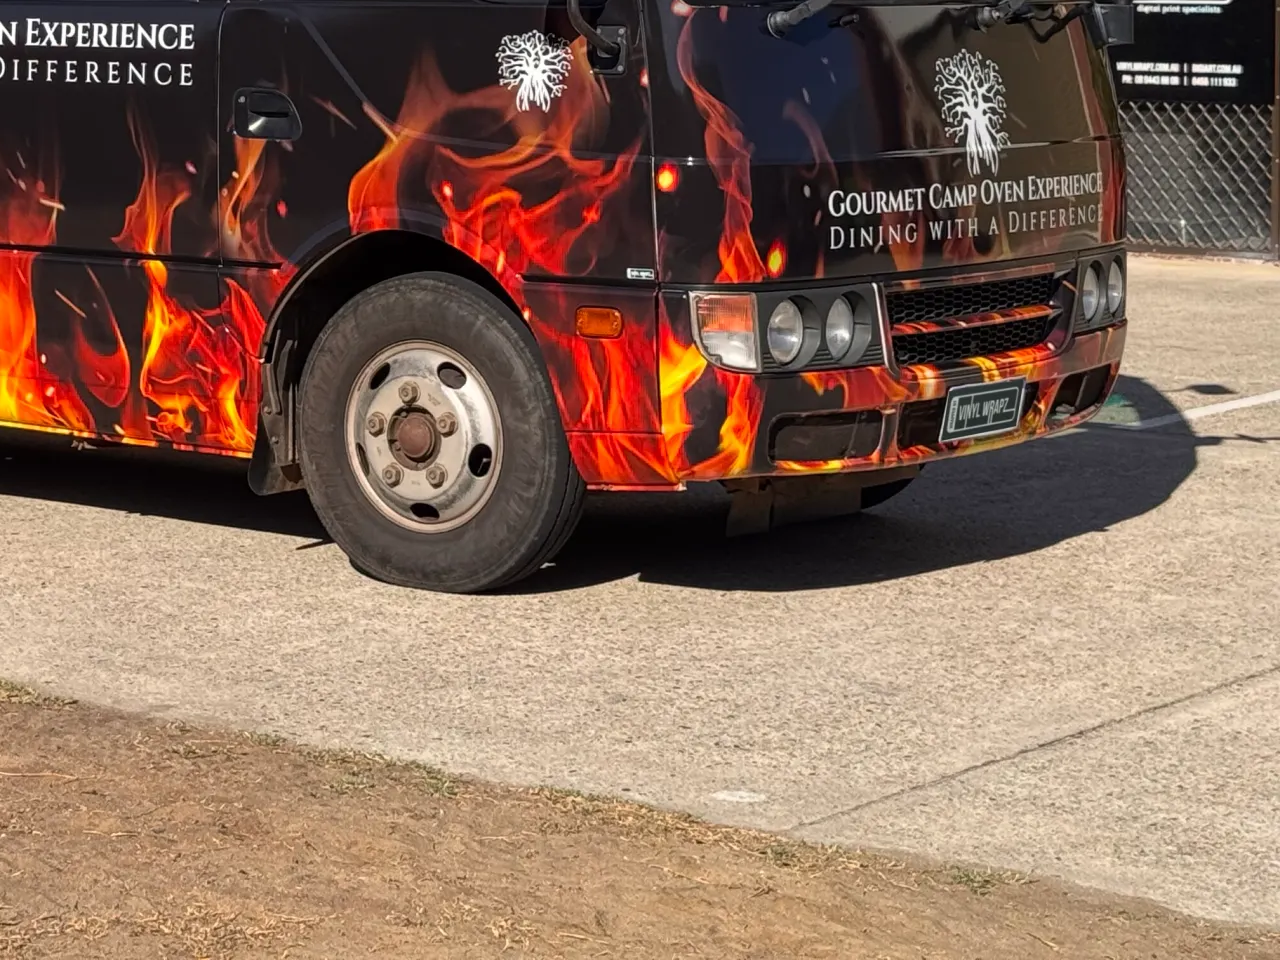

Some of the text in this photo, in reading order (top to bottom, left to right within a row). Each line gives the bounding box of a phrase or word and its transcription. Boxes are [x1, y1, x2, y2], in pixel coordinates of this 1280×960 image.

[1136, 4, 1223, 15] digital print specialists
[24, 17, 195, 50] EXPERIENCE
[828, 171, 1103, 217] GOURMET CAMP OVEN EXPERIENCE
[829, 204, 1104, 250] DINING WITH A DIFFERENCE
[958, 402, 980, 421] VINYL
[982, 397, 1010, 417] WRAPZ
